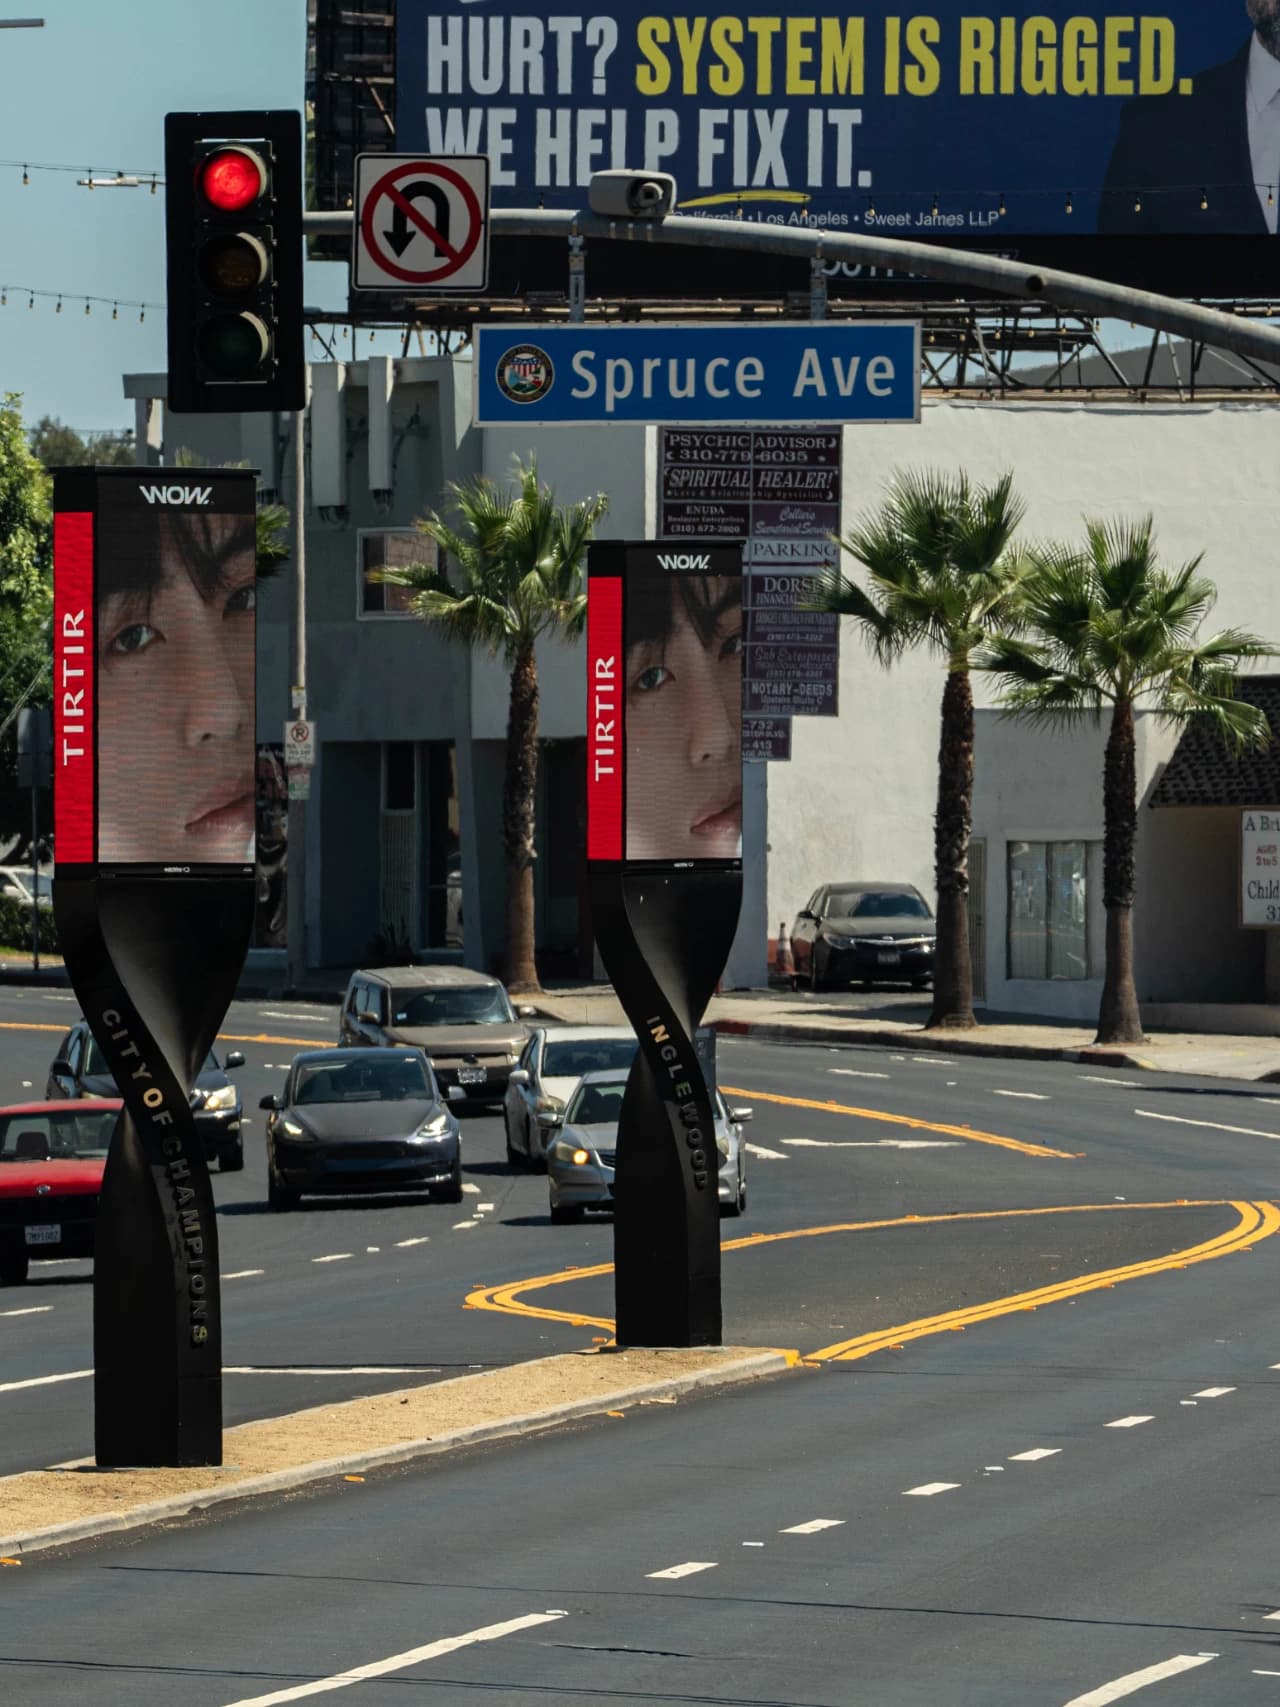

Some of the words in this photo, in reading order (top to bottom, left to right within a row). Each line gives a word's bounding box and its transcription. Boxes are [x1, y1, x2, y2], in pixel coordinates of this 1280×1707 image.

[426, 16, 619, 95] HURT?
[635, 16, 865, 96] SYSTEM
[884, 16, 941, 96] IS
[959, 16, 1193, 96] RIGGED.
[425, 107, 517, 187] WE
[535, 107, 679, 187] HELP
[697, 108, 789, 188] FIX
[807, 108, 872, 188] IT.
[758, 210, 784, 225] Los
[788, 210, 849, 228] Angeles
[864, 210, 911, 227] Sweet
[915, 211, 964, 227] James
[969, 210, 999, 227] LLP
[570, 349, 765, 413] Spruce
[792, 347, 896, 398] Ave
[669, 433, 750, 448] PSYCHIC
[754, 436, 827, 449] ADVISOR
[669, 468, 751, 488] SPIRITUAL
[758, 471, 834, 489] HEALER!
[753, 543, 838, 557] PARKING
[63, 609, 84, 766] TIRTIR
[595, 656, 615, 782] TIRTIR
[1244, 815, 1257, 832] A
[646, 1015, 709, 1190] INGLEWOOD
[101, 1008, 153, 1081] CITY
[142, 1086, 173, 1126] OF
[161, 1134, 208, 1345] CHAMPIONS
